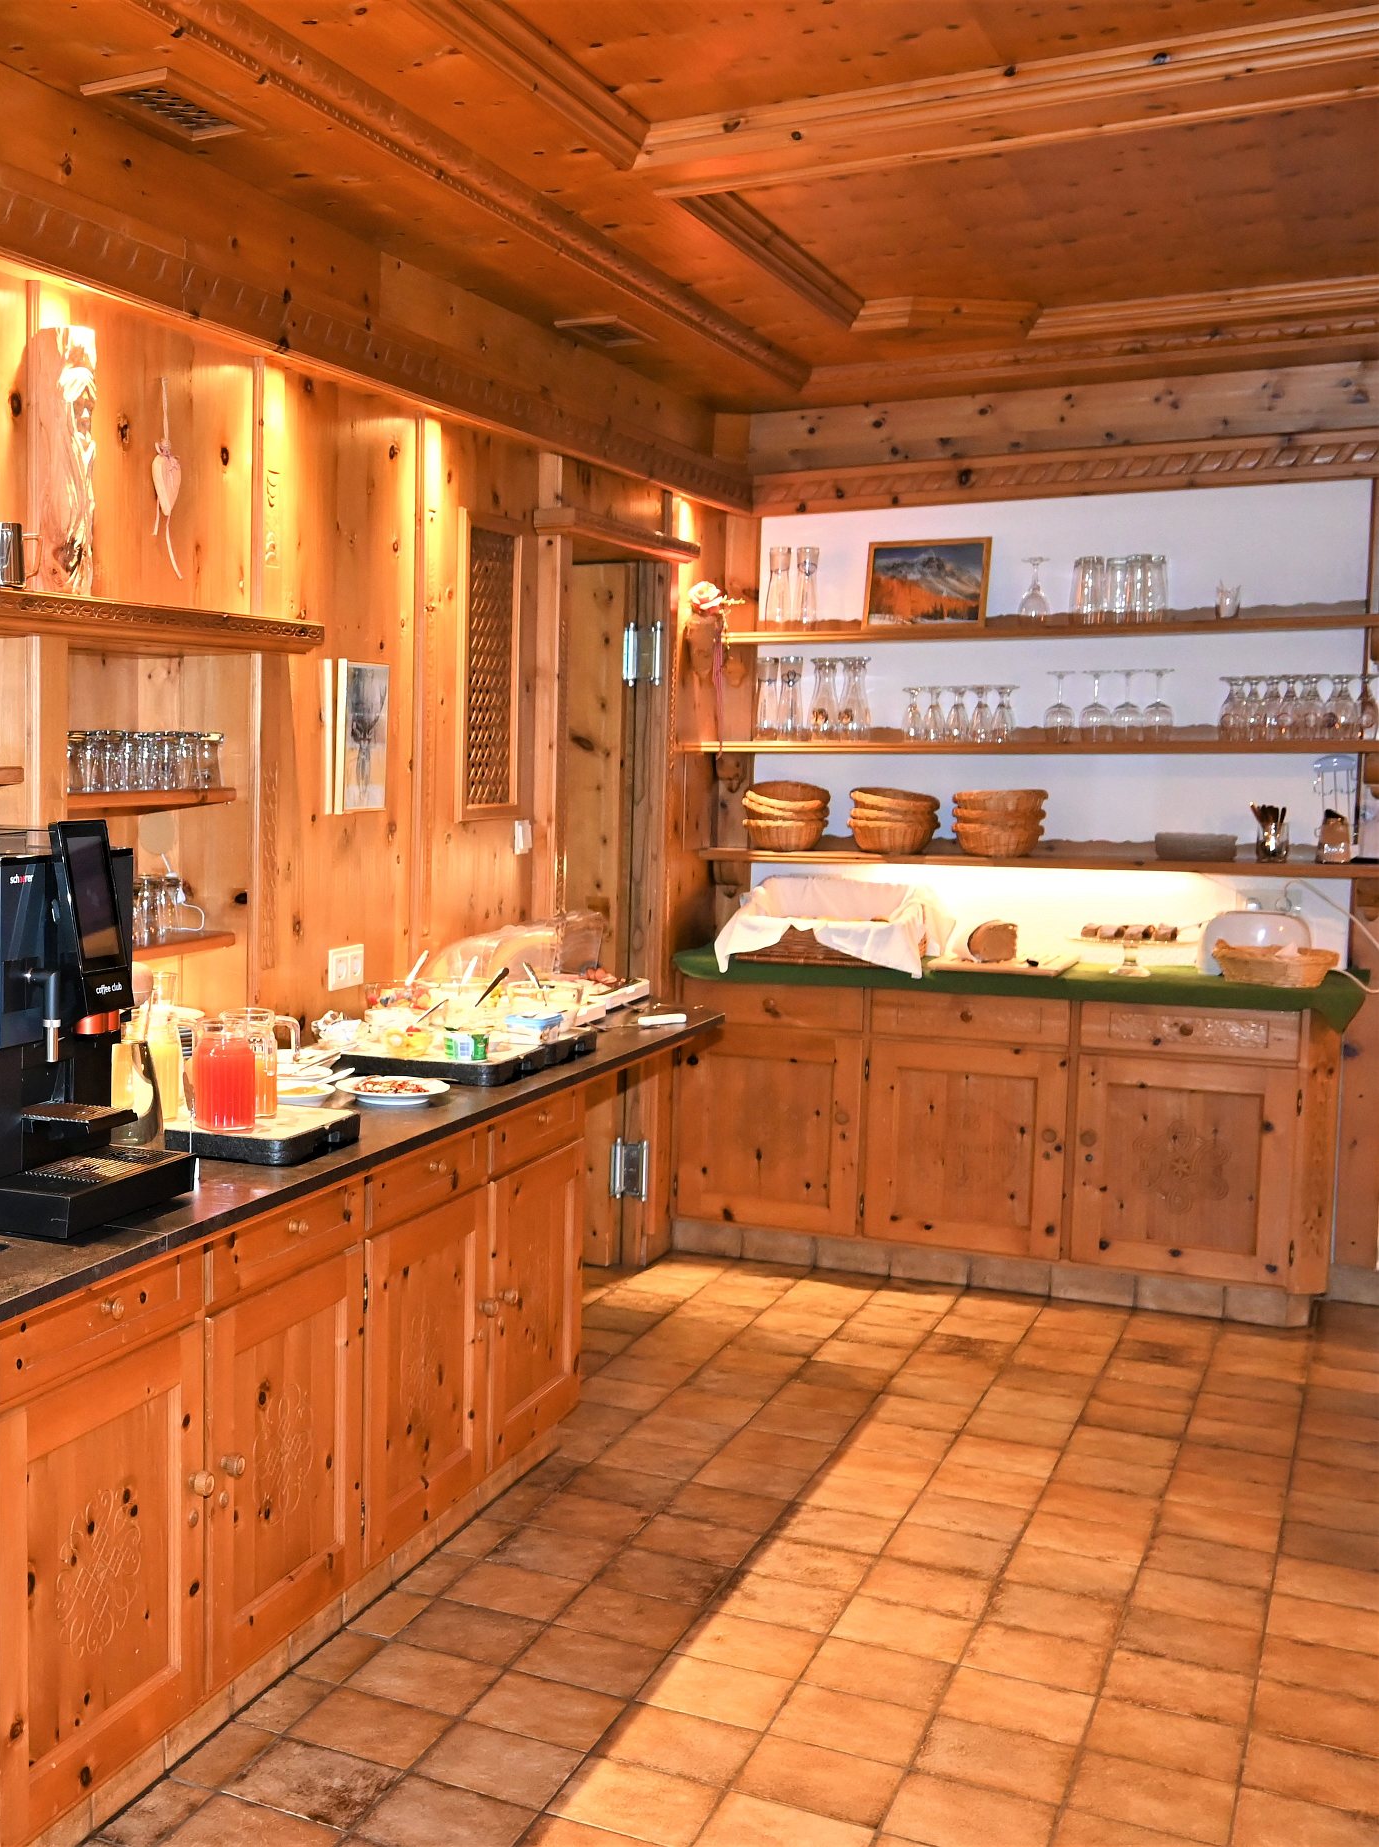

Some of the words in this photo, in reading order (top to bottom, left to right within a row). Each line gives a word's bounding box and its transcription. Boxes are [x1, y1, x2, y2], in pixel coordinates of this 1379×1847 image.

[9, 873, 34, 884] schaerer
[95, 984, 111, 995] coffee
[111, 981, 123, 992] club
